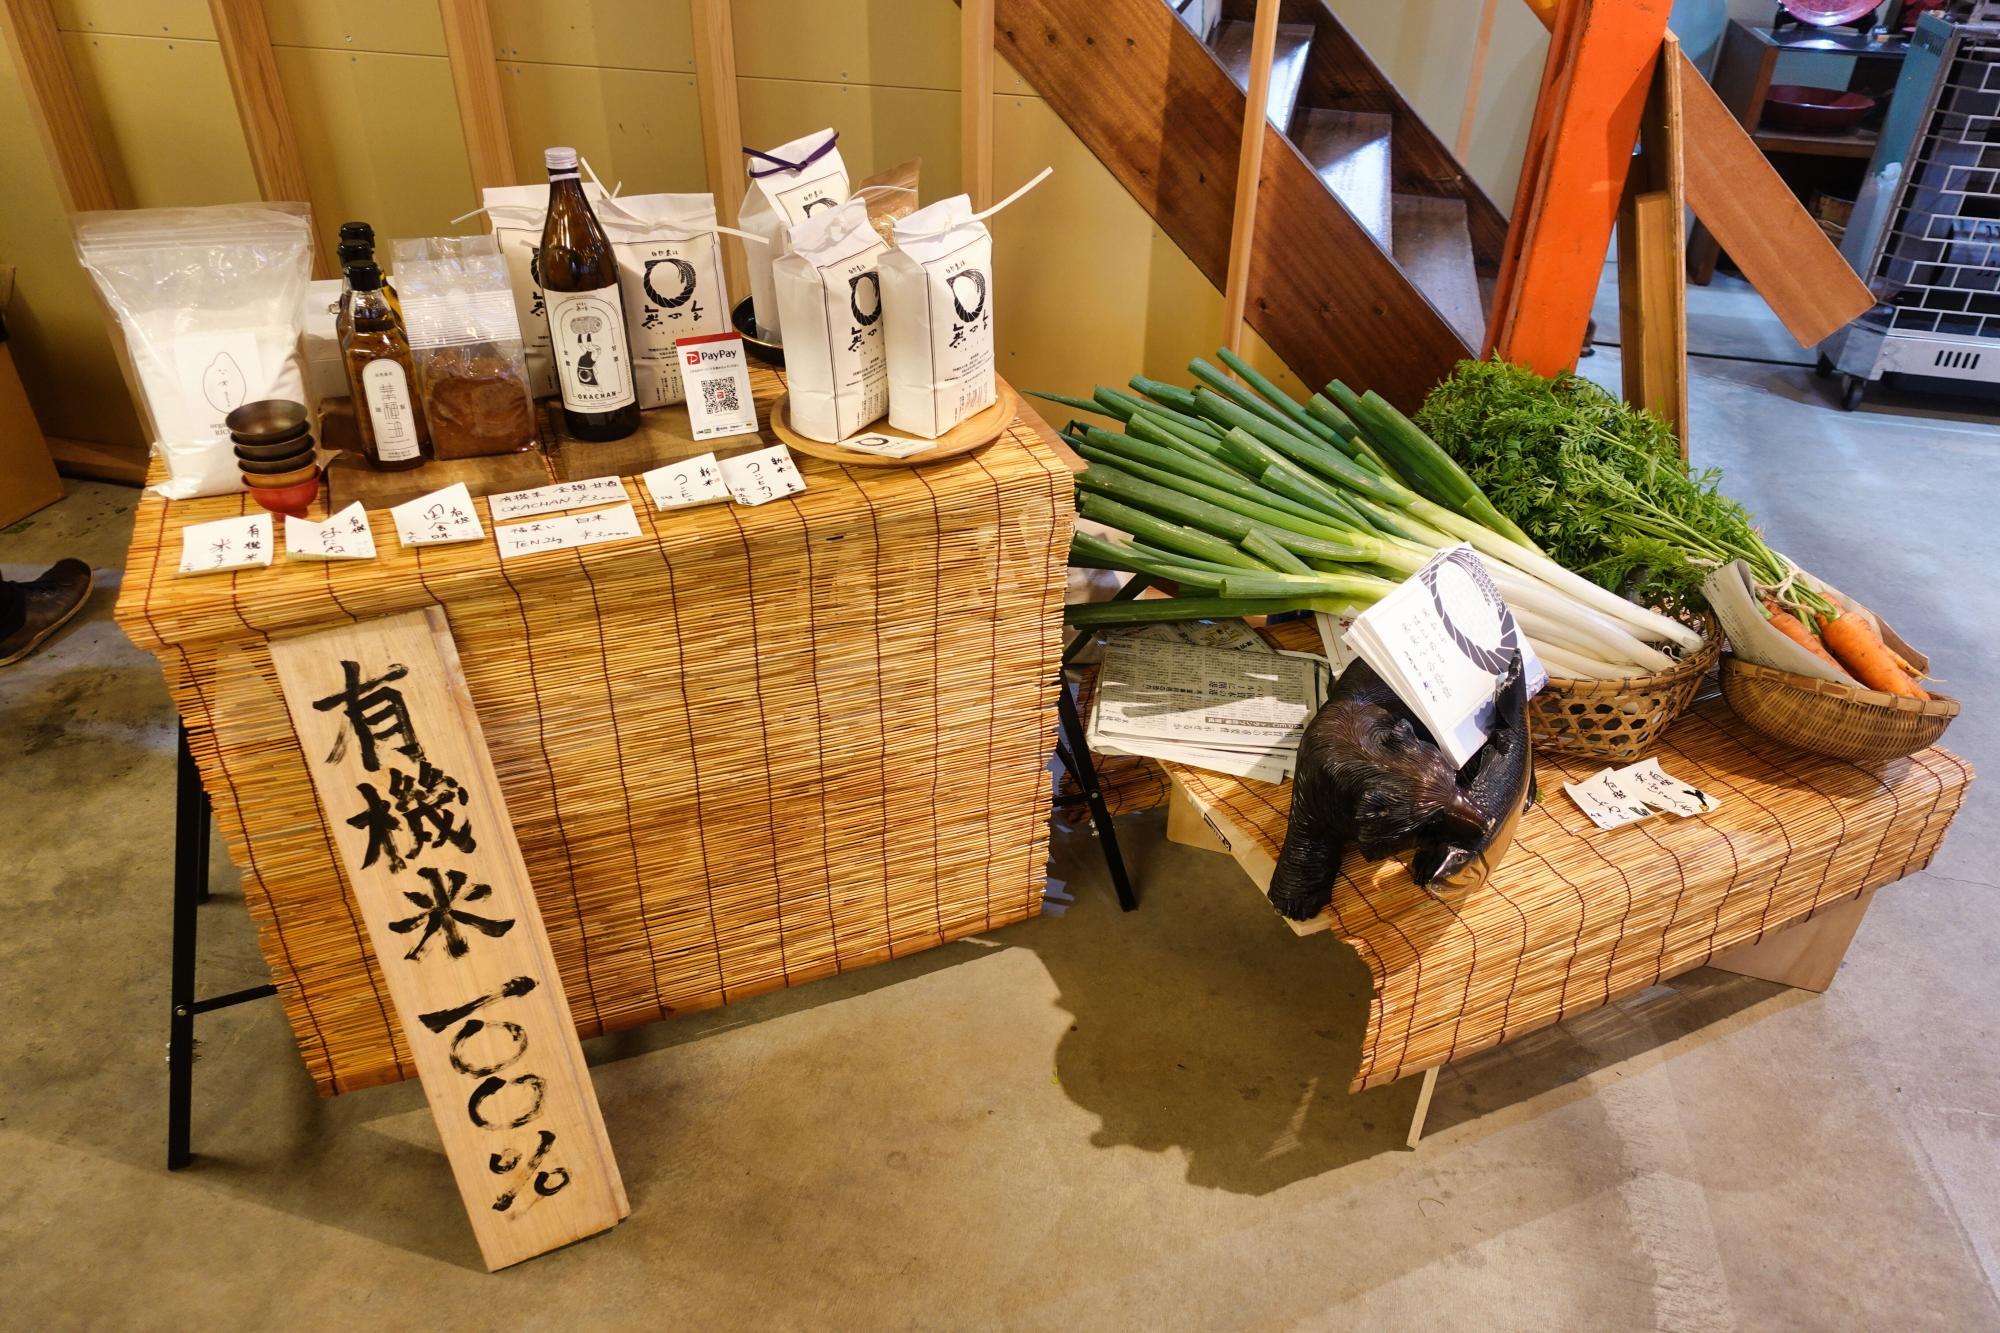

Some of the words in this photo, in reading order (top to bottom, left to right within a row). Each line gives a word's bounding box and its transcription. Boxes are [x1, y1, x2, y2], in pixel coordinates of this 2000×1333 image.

[701, 349, 737, 361] PayPay
[577, 391, 617, 400] OKACHAN
[312, 658, 516, 963] 有機米
